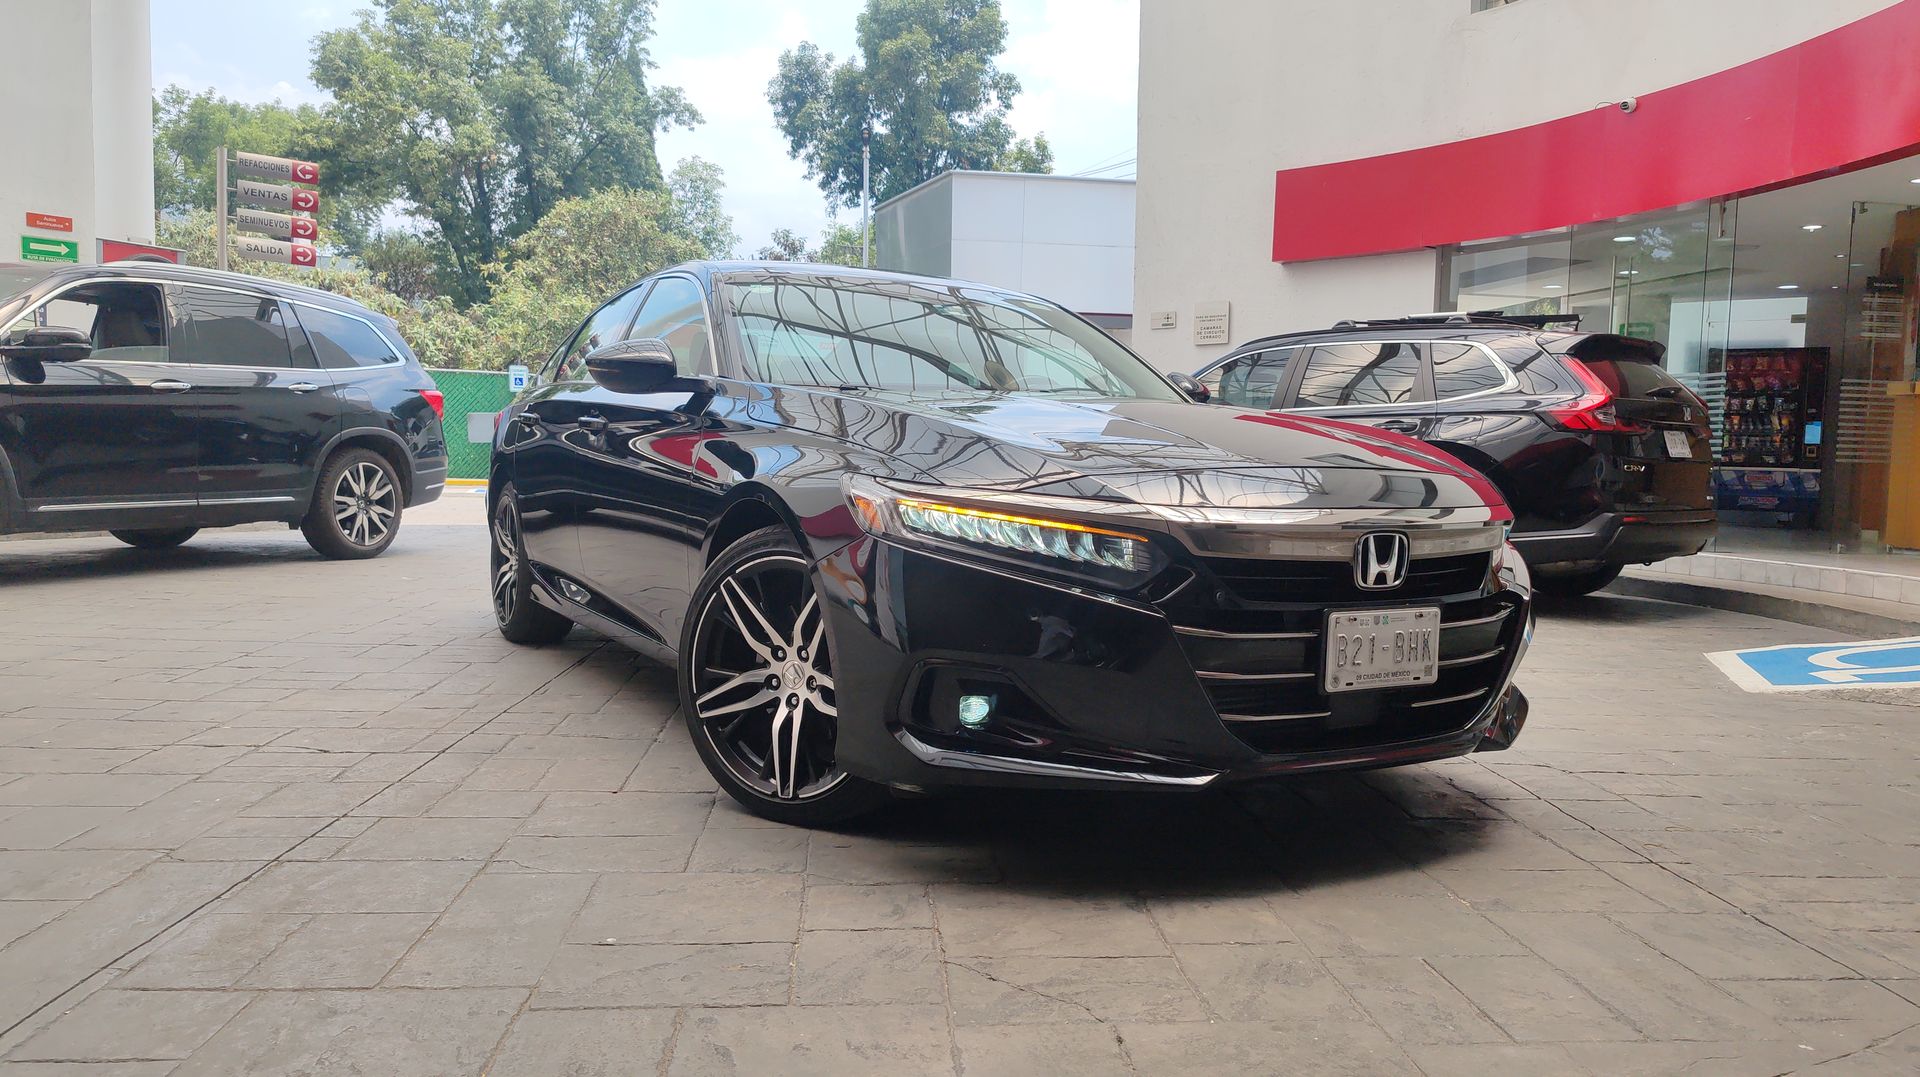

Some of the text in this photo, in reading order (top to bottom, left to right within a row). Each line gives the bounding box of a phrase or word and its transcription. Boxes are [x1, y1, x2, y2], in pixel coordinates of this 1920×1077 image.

[239, 158, 290, 173] REFACCIONES
[243, 187, 288, 201] VENTAS
[239, 214, 290, 229] SEMINUEVOS
[246, 243, 284, 256] SALIDA
[1356, 673, 1362, 681] 09
[1363, 672, 1382, 680] CIUDAD
